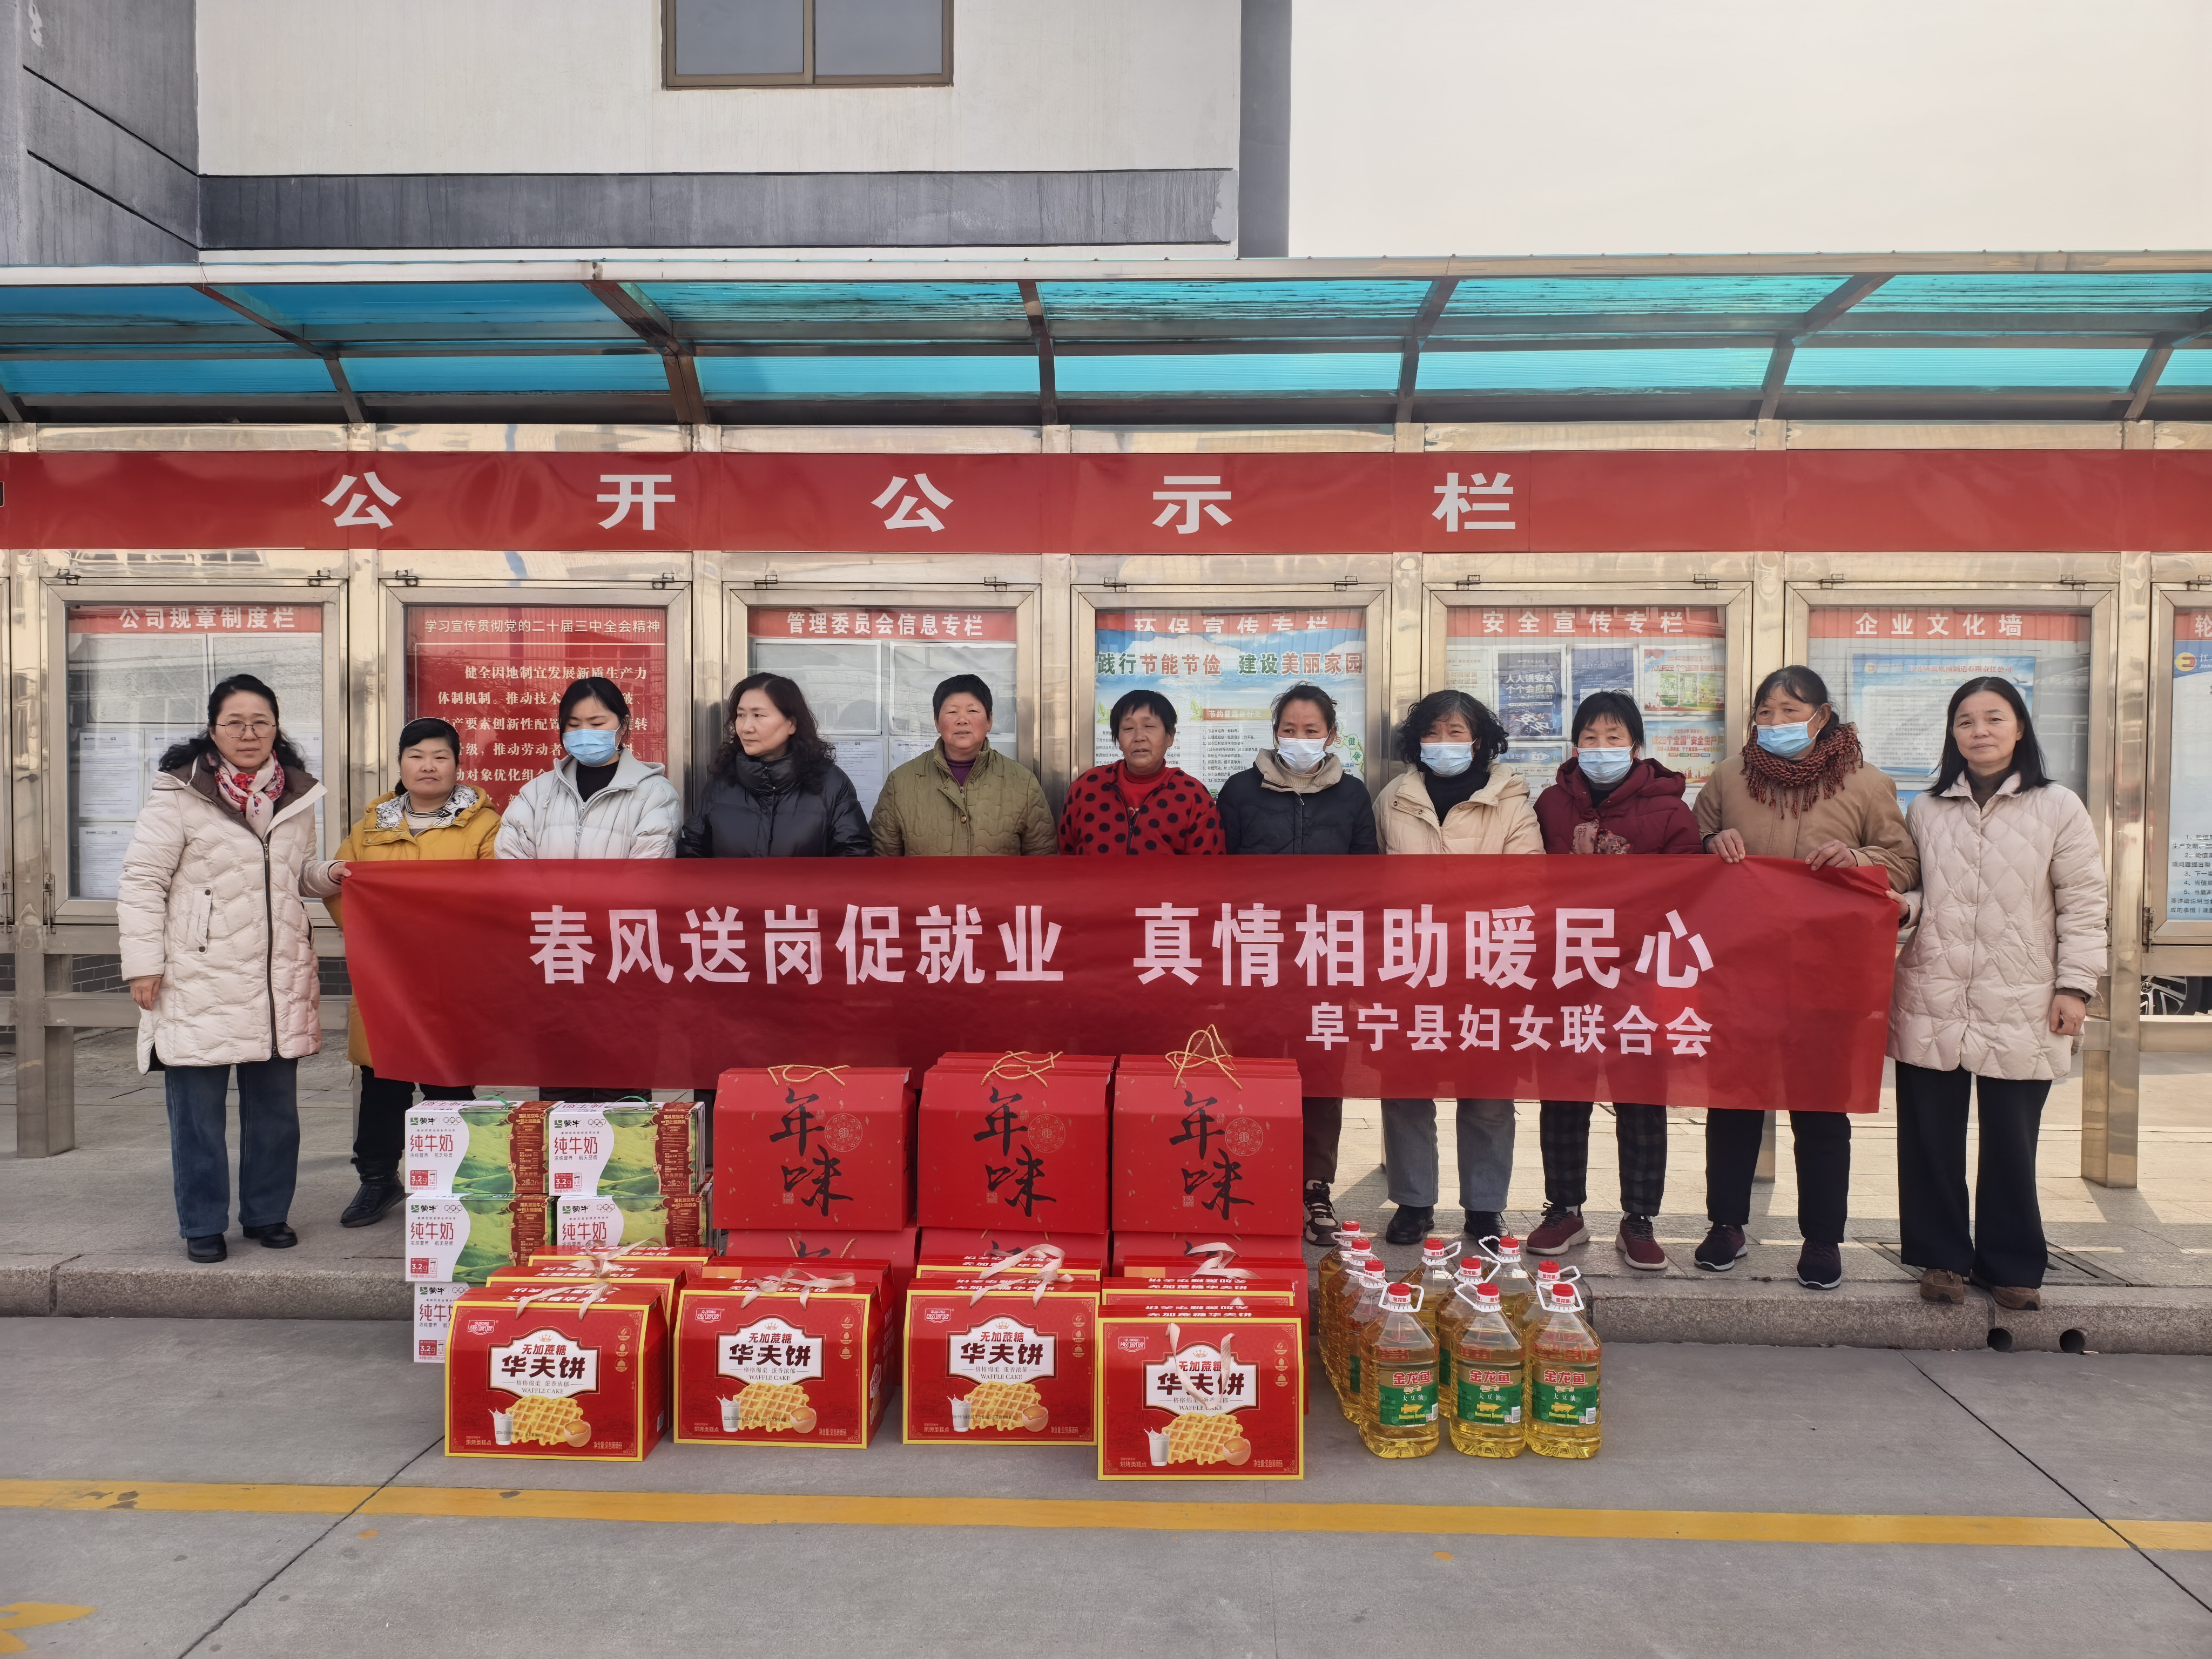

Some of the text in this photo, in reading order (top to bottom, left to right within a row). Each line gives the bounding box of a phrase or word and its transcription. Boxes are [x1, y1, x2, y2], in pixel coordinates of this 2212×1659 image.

[119, 607, 295, 629] 公司规章制度栏
[424, 619, 660, 633] 学习宣传贯彻党的二十届三中全会精神
[787, 611, 983, 637] 管理委员会信息专栏
[1134, 616, 1328, 634] 环保宣传专栏
[1482, 610, 1684, 634] 安全宣传专栏
[1855, 612, 2022, 637] 企业文化墙
[1097, 652, 1364, 675] 践行节能节俭 建设美丽家园
[464, 666, 647, 680] 健全因地制宜发展新质生产力
[530, 902, 1714, 990] 春风送岗促就业 真情相助暖民心
[1305, 1001, 1713, 1057] 阜宁县妇女联合会
[410, 1134, 453, 1152] 纯牛奶
[554, 1137, 597, 1155] 纯牛奶
[769, 1087, 854, 1217] 年味
[973, 1087, 1057, 1217] 年味
[1169, 1090, 1255, 1220] 年味
[411, 1176, 427, 1184] 3.2g
[555, 1178, 571, 1187] 3.2g
[410, 1222, 454, 1240] 纯牛奶
[562, 1222, 606, 1240] 纯牛奶
[412, 1264, 428, 1272] 3.2g
[748, 1332, 792, 1344] 无加蔗糖
[980, 1331, 1024, 1343] 无加蔗糖
[420, 1345, 436, 1354] 3.2g
[522, 1344, 567, 1355] 无加蔗糖
[729, 1343, 811, 1367] 华夫饼
[960, 1342, 1043, 1365] 华夫饼
[501, 1355, 585, 1379] 华夫饼
[1178, 1360, 1223, 1372] 无加蔗糖
[1157, 1373, 1244, 1395] 华夫饼
[1392, 1370, 1432, 1386] 金龙鱼
[1469, 1368, 1510, 1384] 金龙鱼
[1543, 1369, 1586, 1385] 金龙鱼
